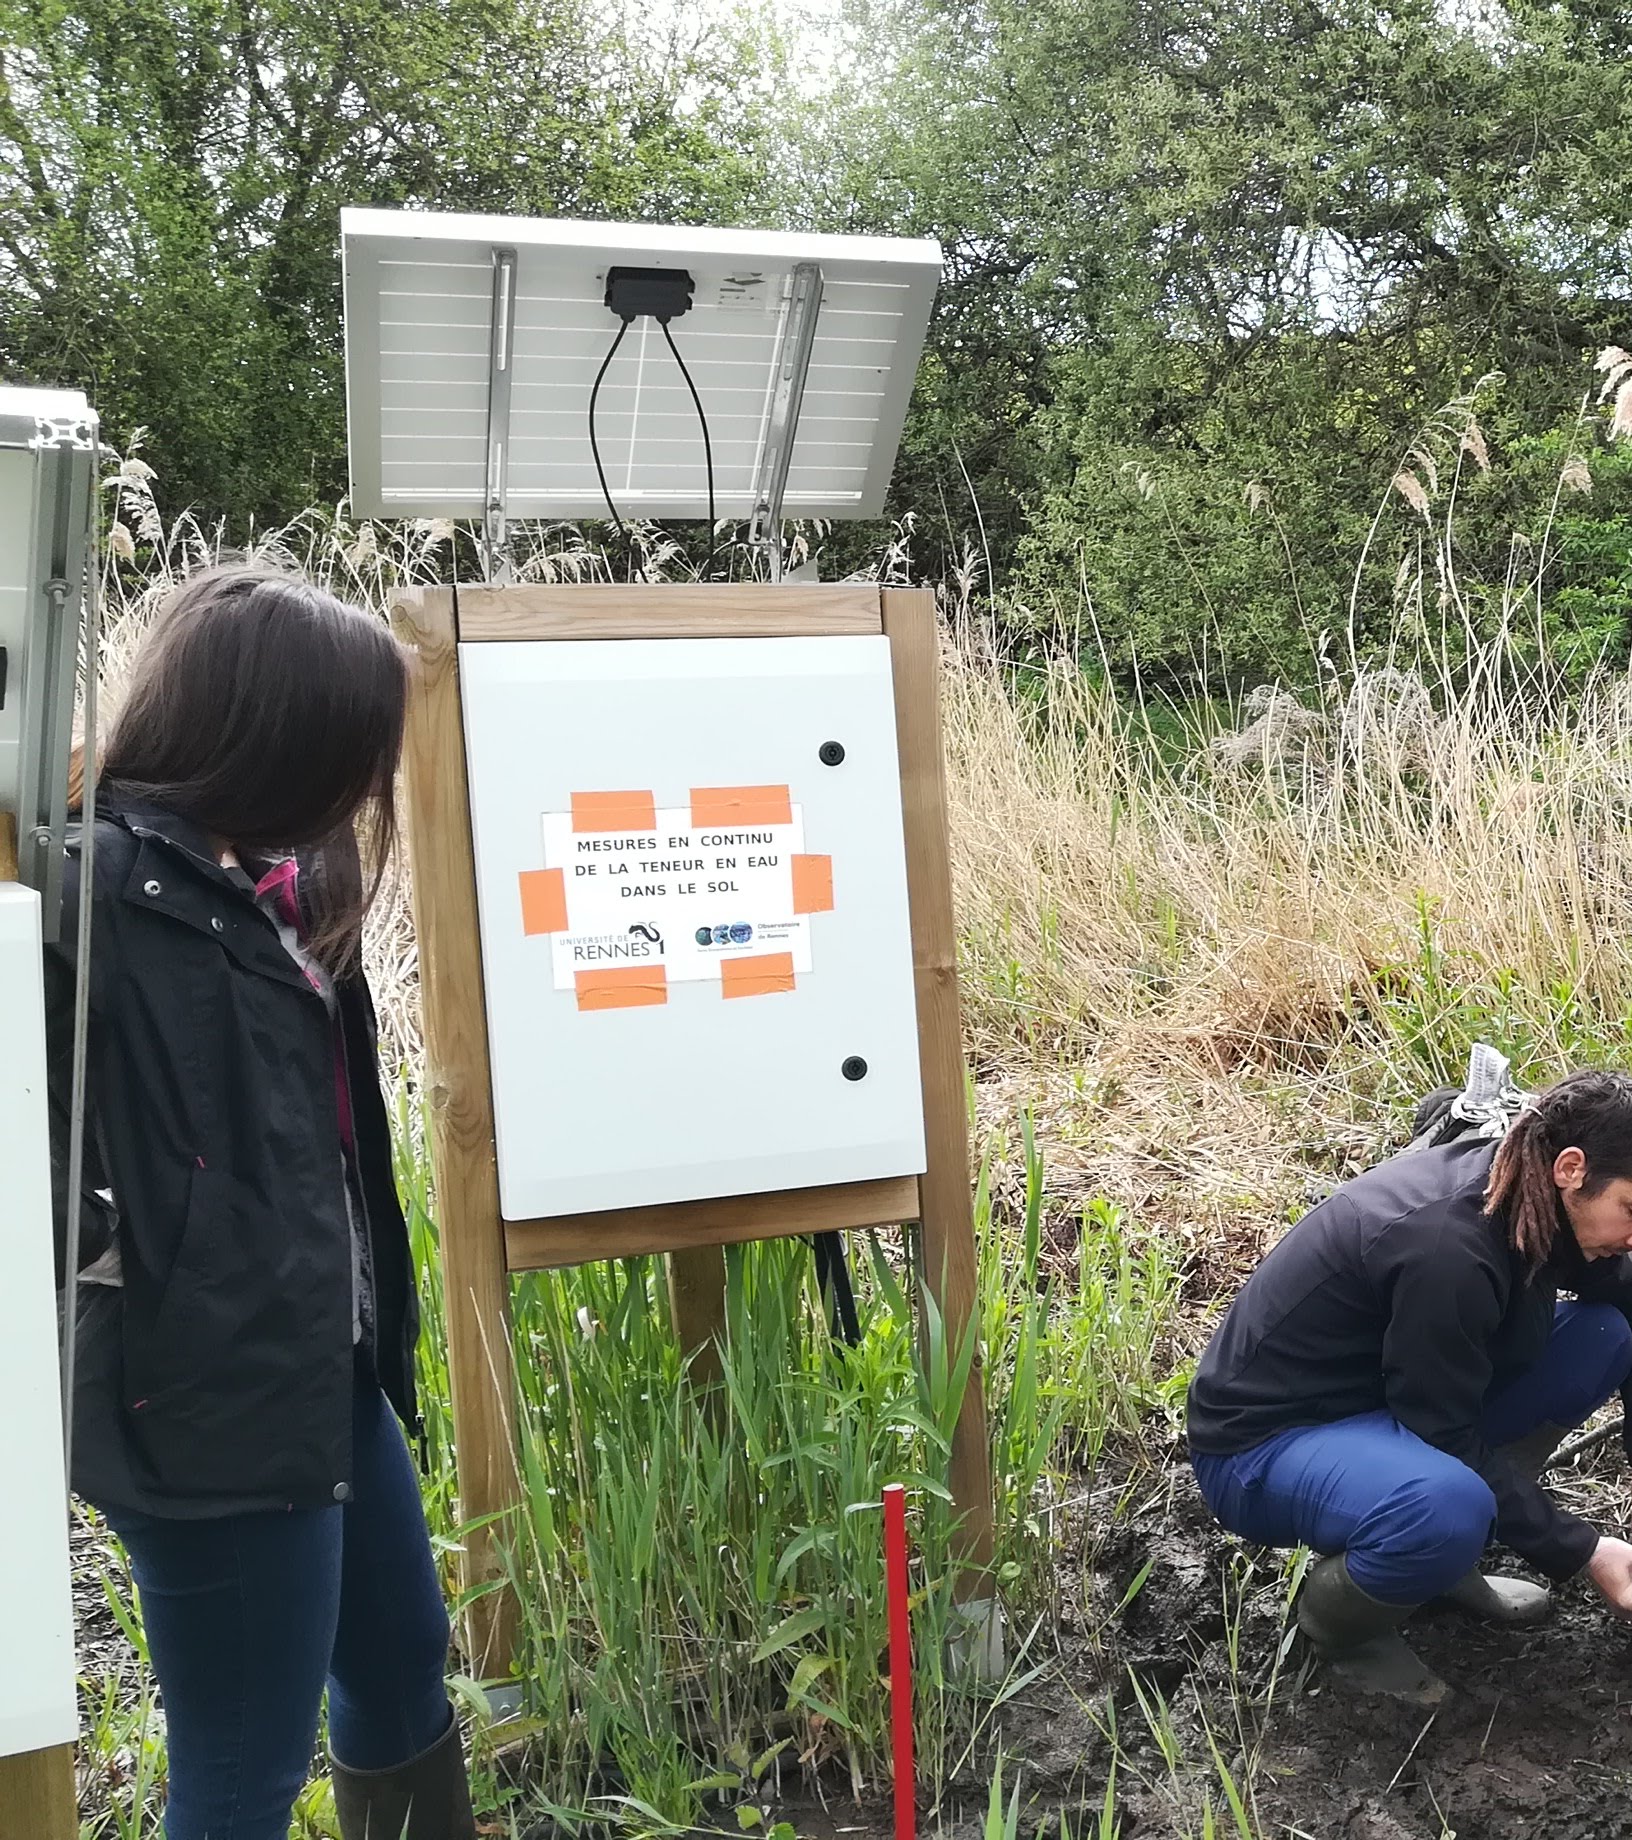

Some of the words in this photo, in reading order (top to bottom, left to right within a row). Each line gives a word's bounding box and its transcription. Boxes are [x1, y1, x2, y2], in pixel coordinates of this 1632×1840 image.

[578, 838, 656, 852] MESURES
[669, 837, 689, 848] EN
[701, 833, 772, 846] CONTINU
[575, 865, 596, 876] DE
[609, 863, 629, 874] LA
[639, 860, 704, 872] TENEUR
[716, 858, 736, 869] EN
[748, 856, 777, 867] EAU
[621, 885, 666, 897] DANS
[678, 883, 696, 894] LE
[708, 881, 739, 892] SOL
[574, 942, 650, 961] RENNES
[657, 940, 665, 955] 1
